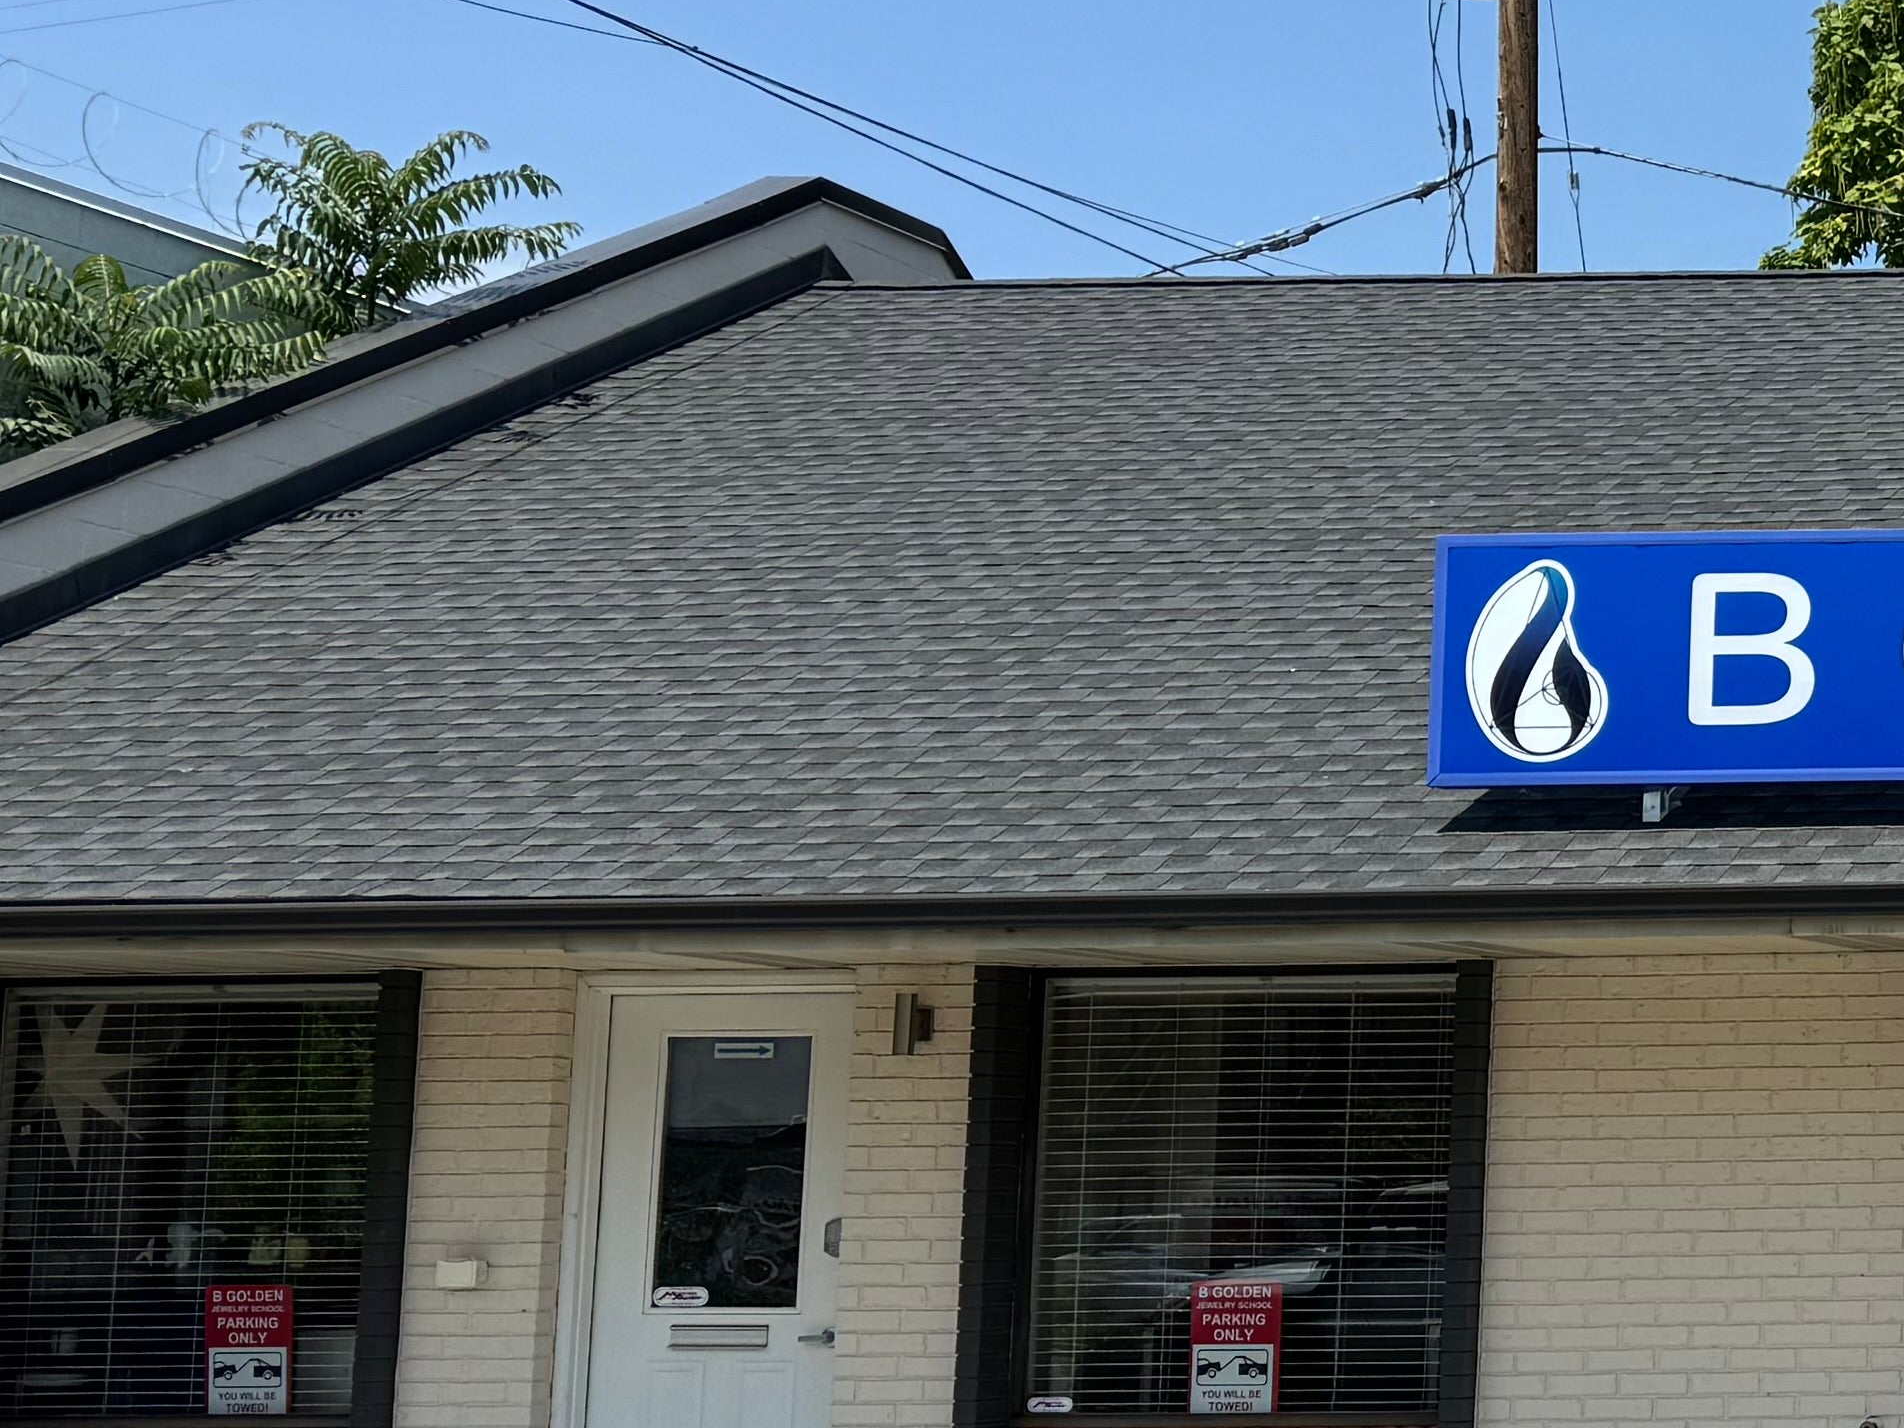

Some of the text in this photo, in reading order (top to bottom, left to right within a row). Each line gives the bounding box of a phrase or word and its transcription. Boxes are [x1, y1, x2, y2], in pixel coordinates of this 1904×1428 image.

[1689, 573, 1814, 725] B
[212, 1290, 283, 1302] B GOLDEN
[1198, 1286, 1271, 1298] B GOLDEN
[217, 1317, 279, 1329] PARKING
[1202, 1313, 1266, 1326] PARKING
[228, 1332, 267, 1344] ONLY
[1213, 1328, 1254, 1341] ONLY
[218, 1392, 276, 1400] YOU WILL BE
[1202, 1390, 1261, 1399] YOU WILL BE
[226, 1403, 268, 1413] TOWED!
[1208, 1401, 1253, 1412] TOWED!
